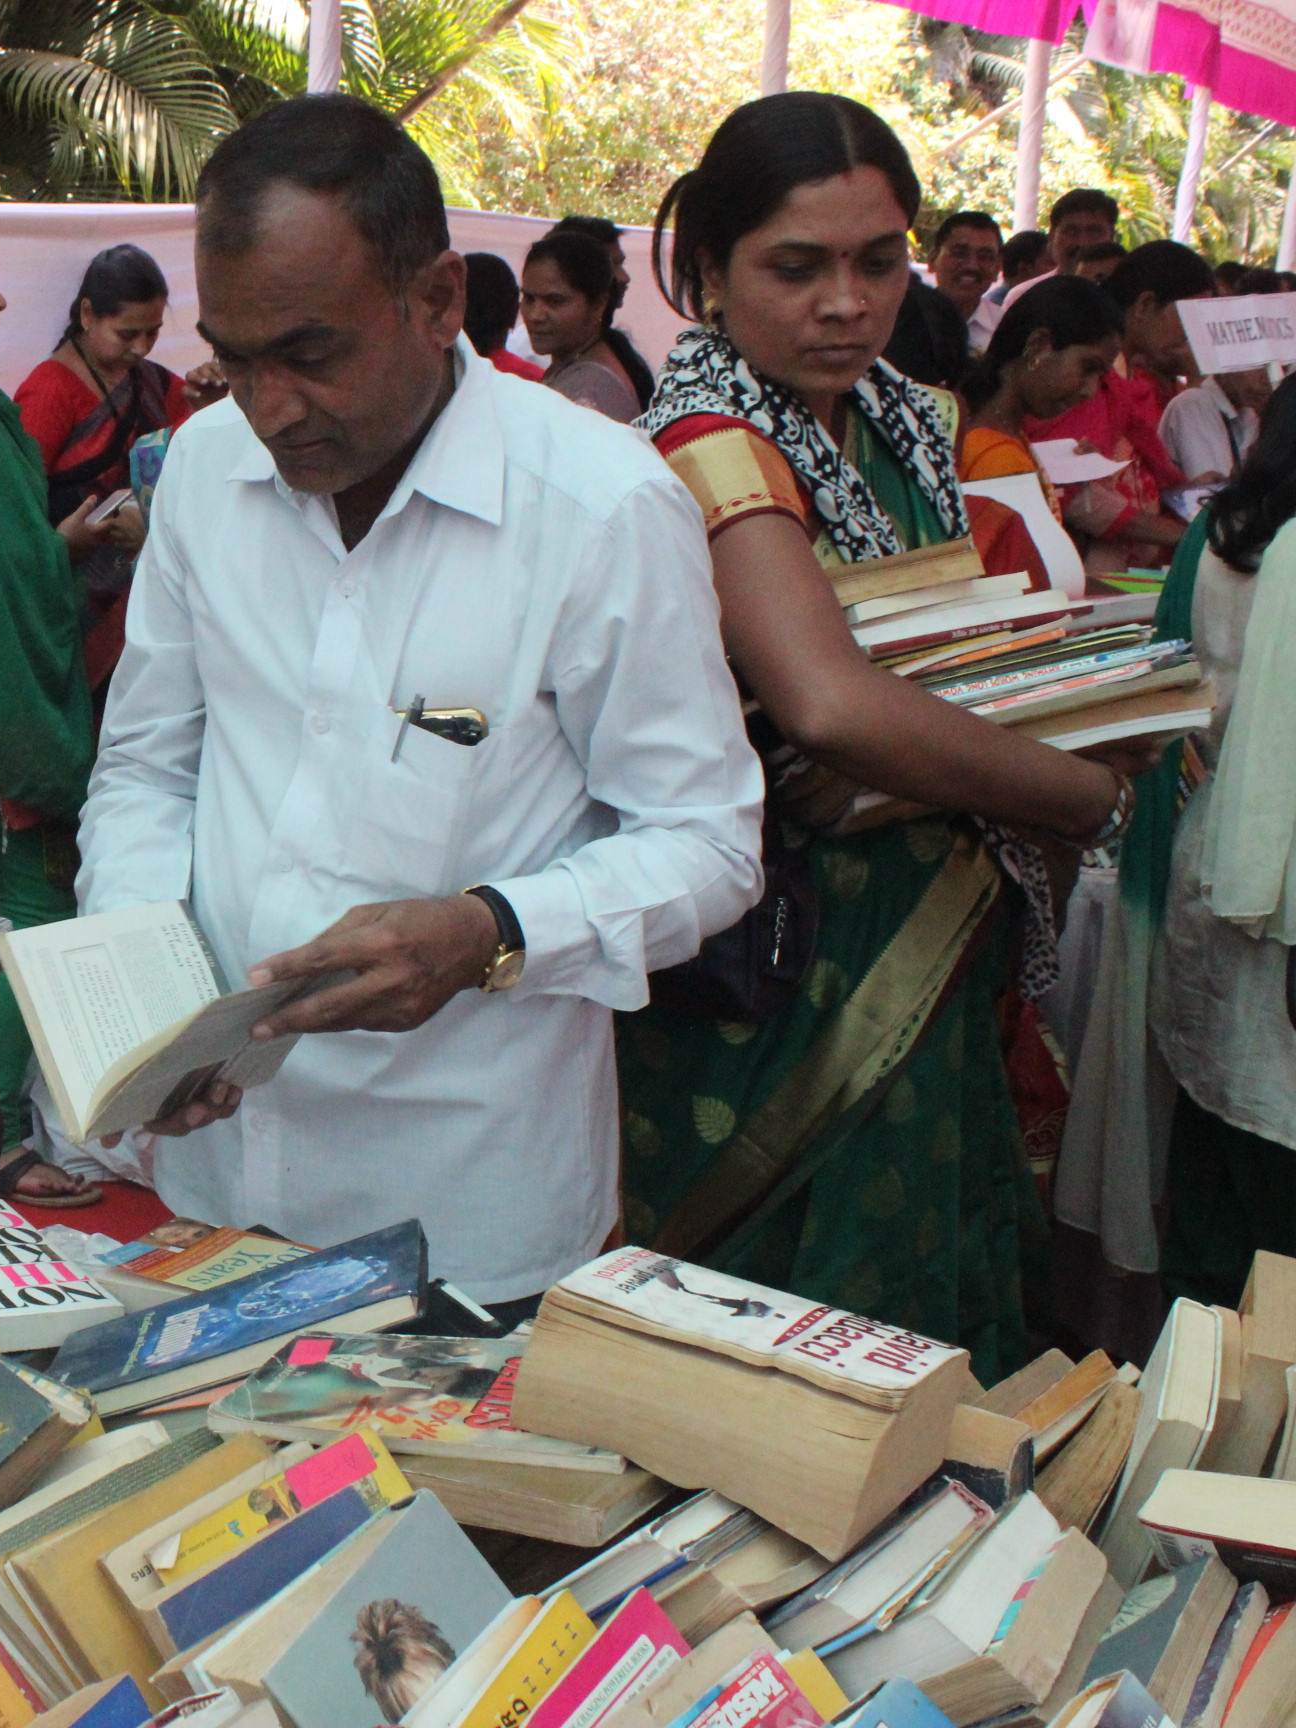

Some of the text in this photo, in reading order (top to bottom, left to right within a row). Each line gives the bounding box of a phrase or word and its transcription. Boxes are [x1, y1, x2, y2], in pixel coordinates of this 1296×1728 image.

[186, 1249, 272, 1286] Years
[592, 1256, 638, 1282] control
[614, 1268, 655, 1295] power
[603, 1663, 633, 1695] POWERFUL
[631, 1643, 650, 1666] BOOKS
